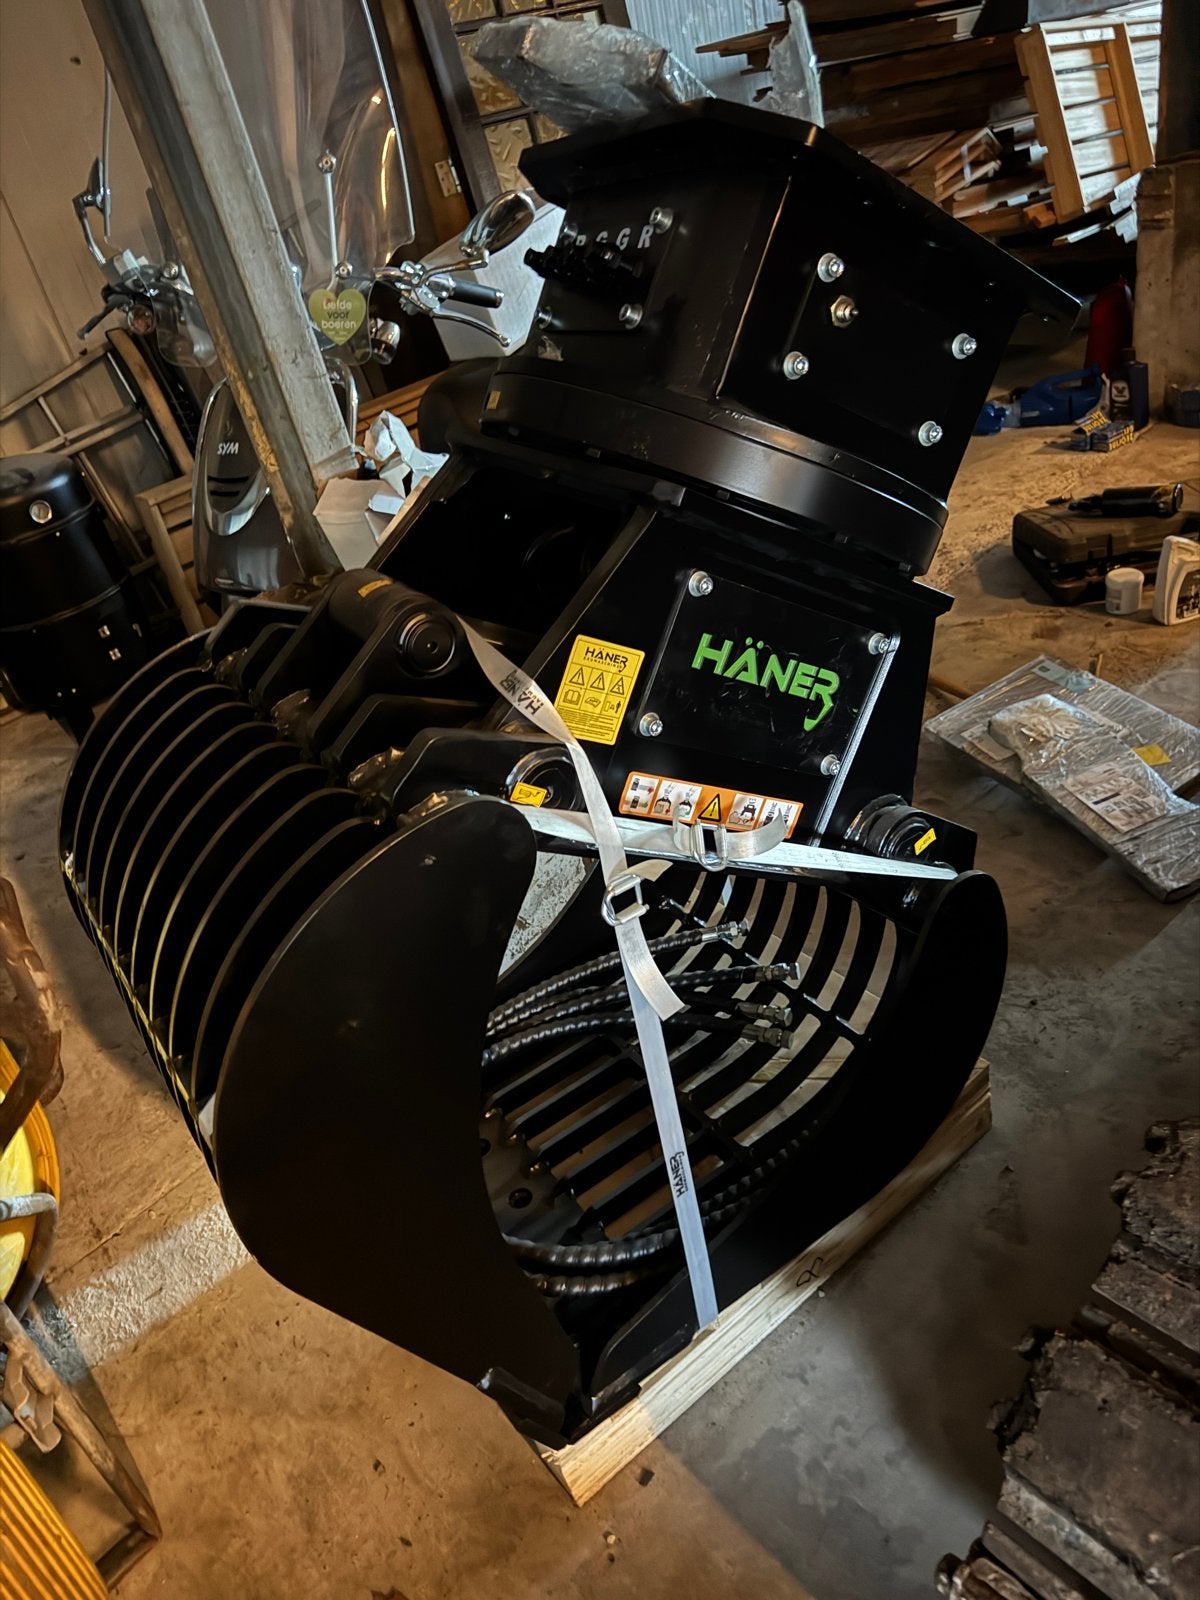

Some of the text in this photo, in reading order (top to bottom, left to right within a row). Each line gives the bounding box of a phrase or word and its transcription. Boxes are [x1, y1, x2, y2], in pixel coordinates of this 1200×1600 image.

[616, 227, 631, 250] G
[637, 224, 654, 249] R
[321, 320, 356, 329] boeren
[326, 311, 349, 319] voor
[217, 441, 239, 456] SYM
[584, 646, 629, 673] HÄNER
[691, 632, 840, 732] HÄNER
